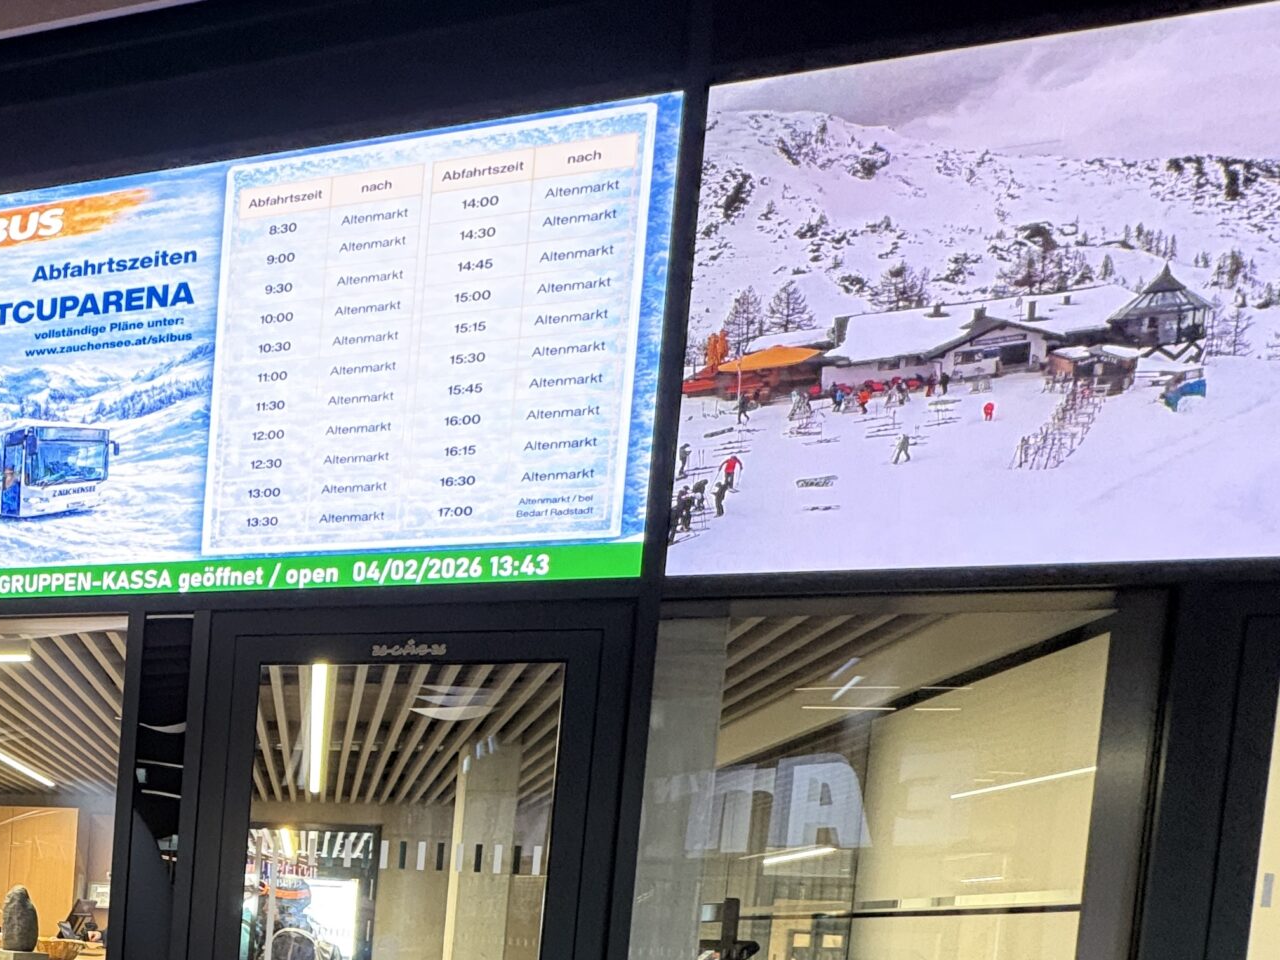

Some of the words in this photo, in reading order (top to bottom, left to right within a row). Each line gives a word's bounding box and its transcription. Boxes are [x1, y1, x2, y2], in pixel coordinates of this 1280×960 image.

[568, 150, 601, 164] nach
[442, 162, 524, 181] Abfahrtszeit
[362, 180, 392, 192] nach
[545, 180, 619, 199] Altenmarkt
[249, 190, 322, 208] Abfahrtszeit
[462, 196, 499, 209] 14:00
[341, 208, 408, 226] Altenmarkt
[542, 209, 617, 227] Altenmarkt
[269, 222, 297, 235] 8:30
[460, 227, 496, 240] 14:30
[339, 236, 406, 252] Altenmarkt
[267, 252, 295, 264] 9:00
[540, 245, 614, 263] Altenmarkt
[32, 251, 197, 282] Abfahrtszeiten
[458, 259, 493, 272] 14:45
[337, 270, 403, 286] Altenmarkt
[265, 282, 293, 295] 9:30
[537, 277, 611, 294] Altenmarkt
[455, 290, 491, 302] 15:00
[335, 301, 400, 316] Altenmarkt
[261, 312, 293, 324] 10:00
[534, 309, 608, 325] Altenmarkt
[34, 323, 106, 340] vollständige
[110, 321, 144, 332] Pläne
[147, 318, 184, 328] unter:
[455, 321, 486, 333] 15:15
[24, 331, 193, 358] www.zauchensee.at/skibus
[332, 331, 398, 346] Altenmarkt
[259, 341, 291, 353] 10:30
[532, 341, 605, 357] Altenmarkt
[450, 352, 485, 364] 15:30
[330, 362, 396, 376] Altenmarkt
[258, 371, 287, 382] 11:00
[529, 373, 603, 388] Altenmarkt
[448, 383, 483, 395] 15:45
[328, 392, 394, 405] Altenmarkt
[257, 400, 285, 411] 11:30
[526, 405, 600, 420] Altenmarkt
[445, 414, 481, 426] 16:00
[253, 429, 284, 440] 12:00
[325, 422, 391, 435] Altenmarkt
[445, 445, 476, 456] 16:15
[524, 437, 597, 451] Altenmarkt
[251, 459, 282, 469] 12:30
[323, 452, 389, 464] Altenmarkt
[440, 476, 475, 487] 16:30
[521, 469, 594, 482] Altenmarkt
[52, 486, 95, 497] ZAUCHENSEE
[248, 488, 280, 498] 13:00
[321, 482, 386, 494] Altenmarkt
[519, 496, 570, 505] Altenmarkt
[319, 512, 384, 523] Altenmarkt
[438, 506, 472, 517] 17:00
[516, 509, 548, 517] Bedarf
[550, 507, 593, 516] Radstadt
[247, 517, 278, 527] 13:30
[178, 566, 263, 593] geöffnet
[269, 562, 281, 588] /
[285, 569, 338, 589] open
[352, 556, 482, 584] 04/02/2026
[490, 554, 550, 577] 13:43
